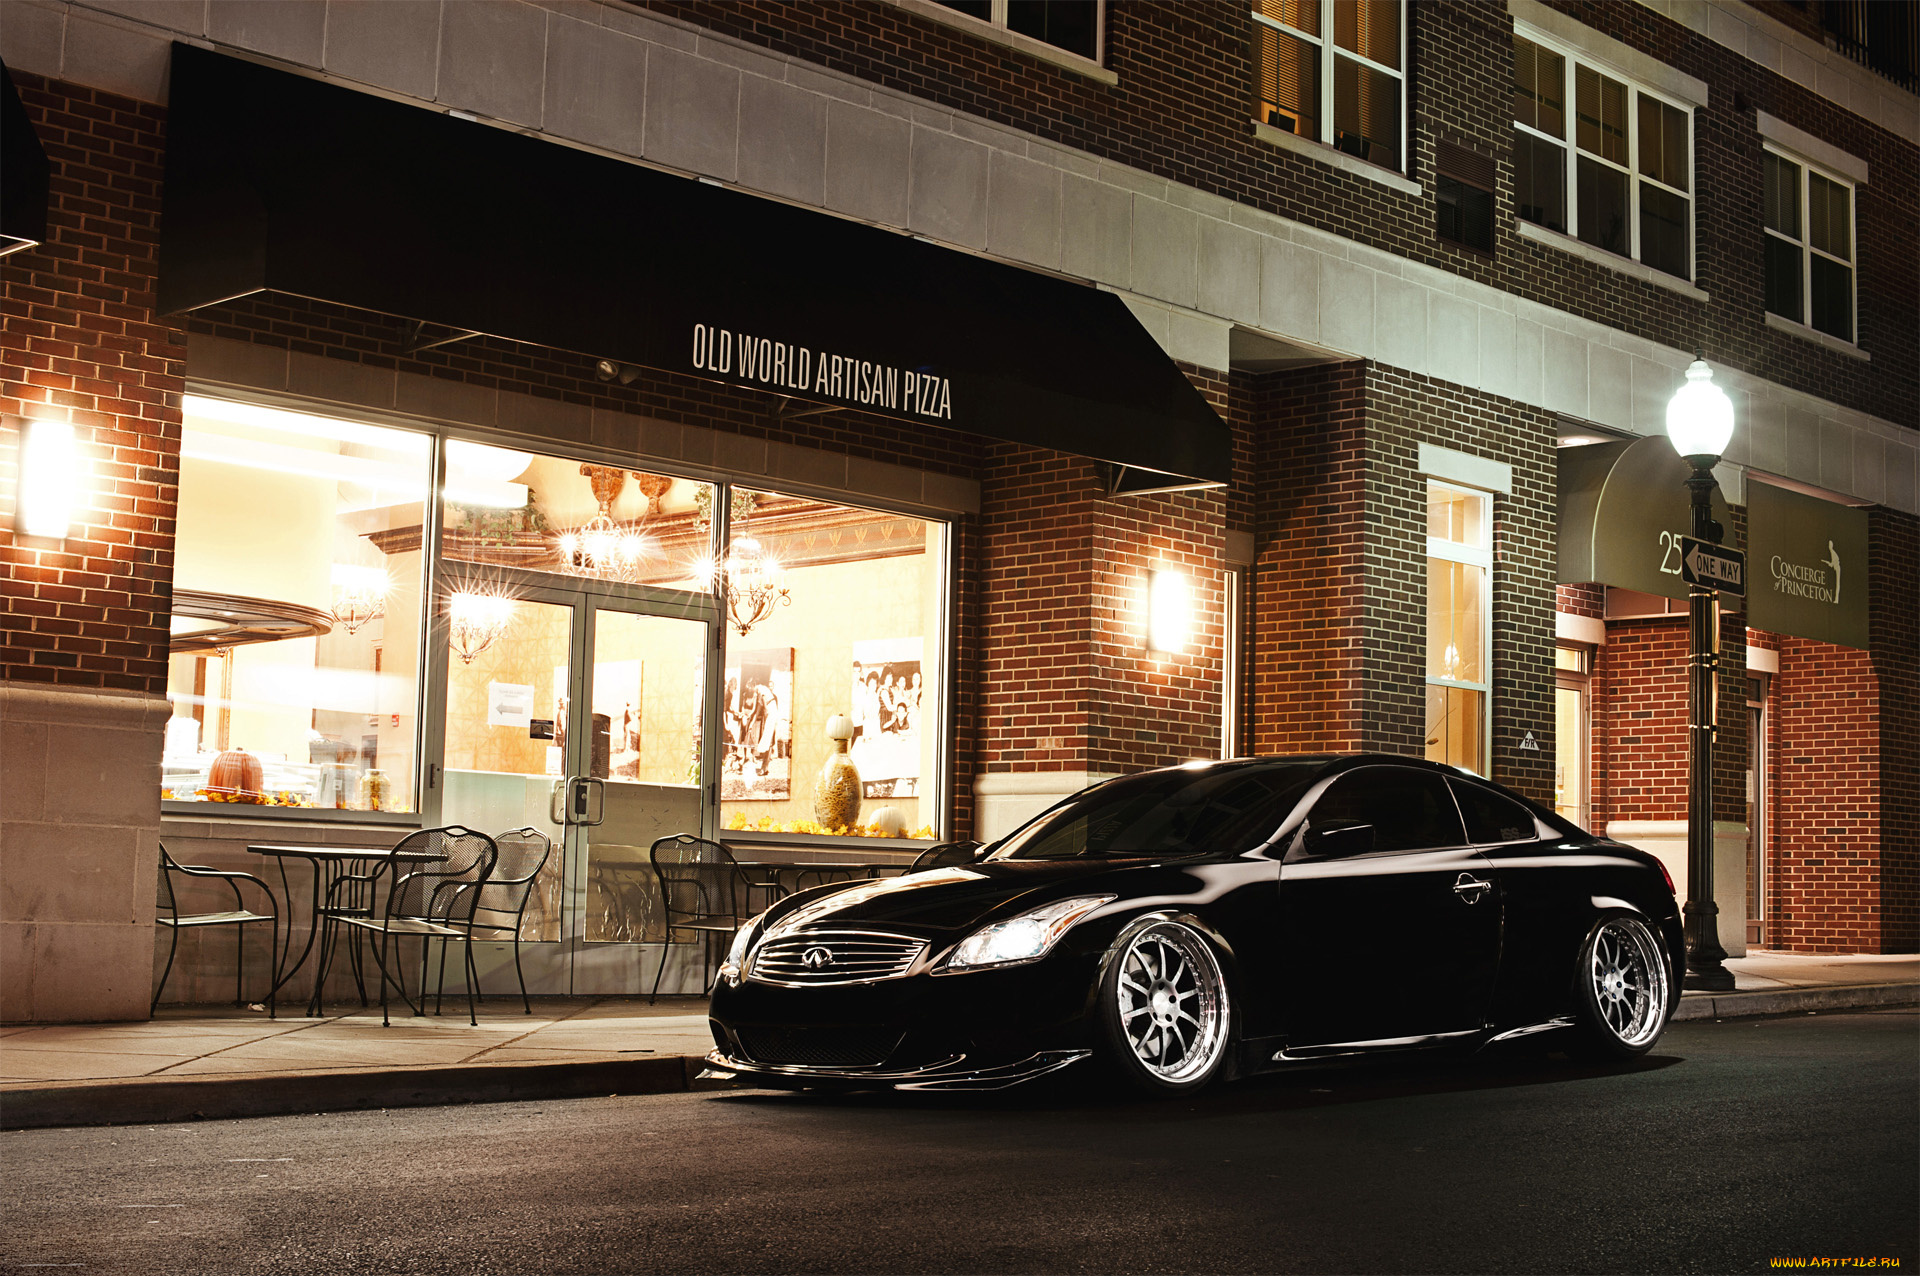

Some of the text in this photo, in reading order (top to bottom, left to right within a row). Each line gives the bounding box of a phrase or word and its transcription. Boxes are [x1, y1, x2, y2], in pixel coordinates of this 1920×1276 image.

[692, 323, 952, 420] OLD WORLD ARTISAN PIZZA
[1696, 554, 1740, 582] ONE WAY
[1770, 555, 1826, 585] CONCIERGE
[1781, 576, 1833, 603] PRINCETON
[1524, 738, 1535, 749] F/R
